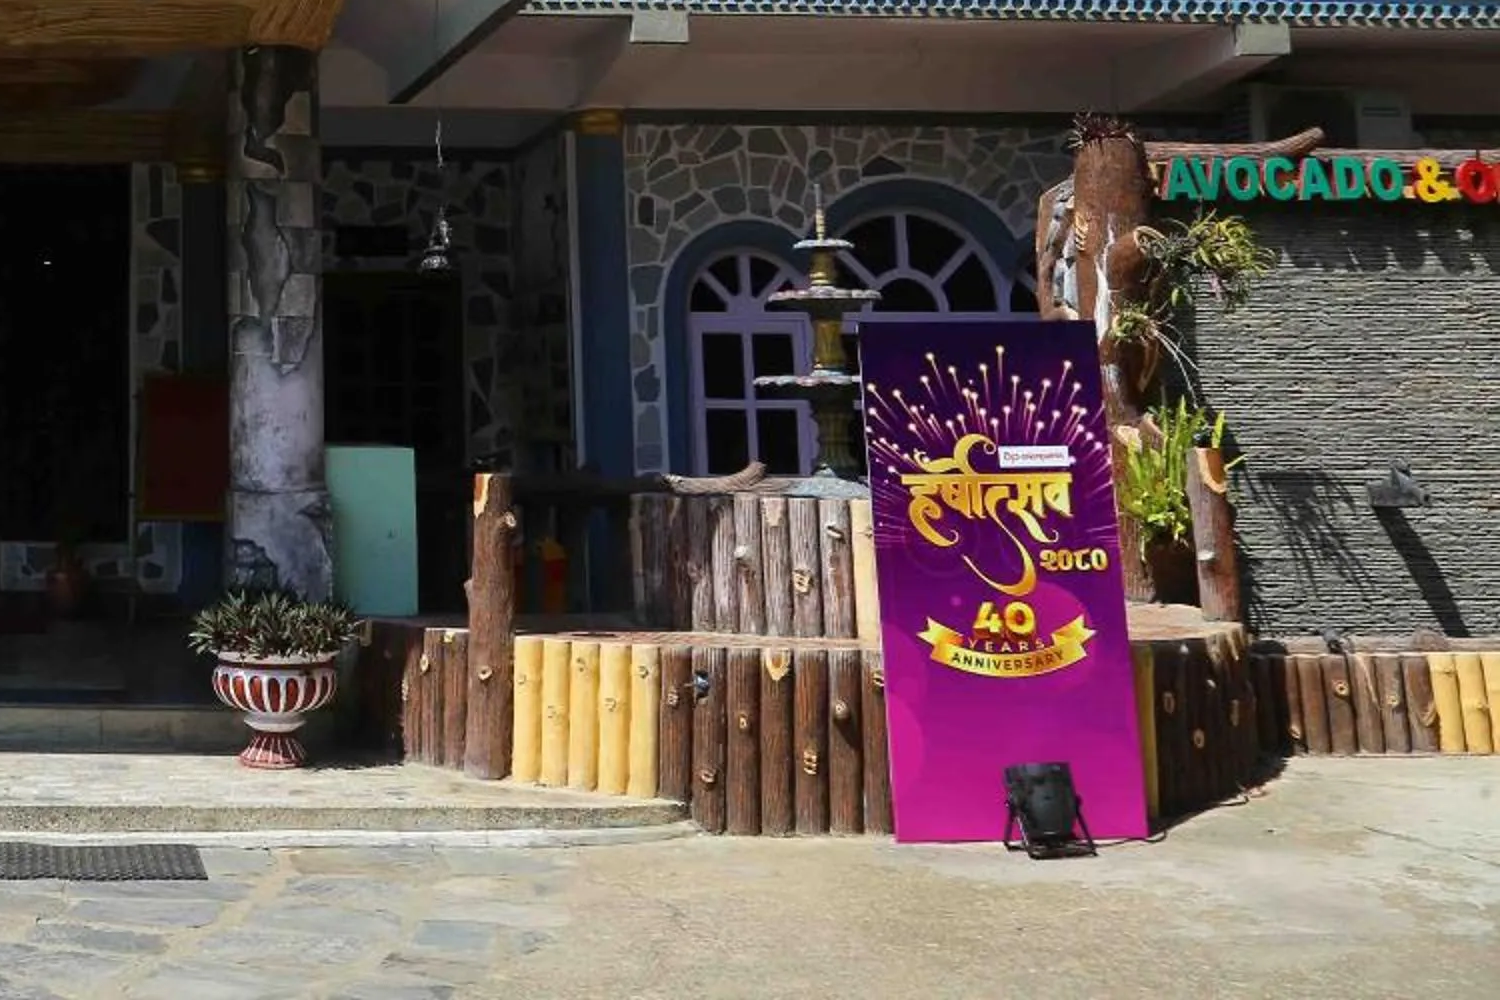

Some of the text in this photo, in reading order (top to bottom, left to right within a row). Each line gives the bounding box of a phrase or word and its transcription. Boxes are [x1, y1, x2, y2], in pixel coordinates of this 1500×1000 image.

[1164, 155, 1402, 201] AVOCADO
[1455, 158, 1500, 204] O
[972, 601, 1036, 638] 40
[967, 637, 1046, 653] YEARS
[952, 649, 1064, 672] ANNIVERSARY
